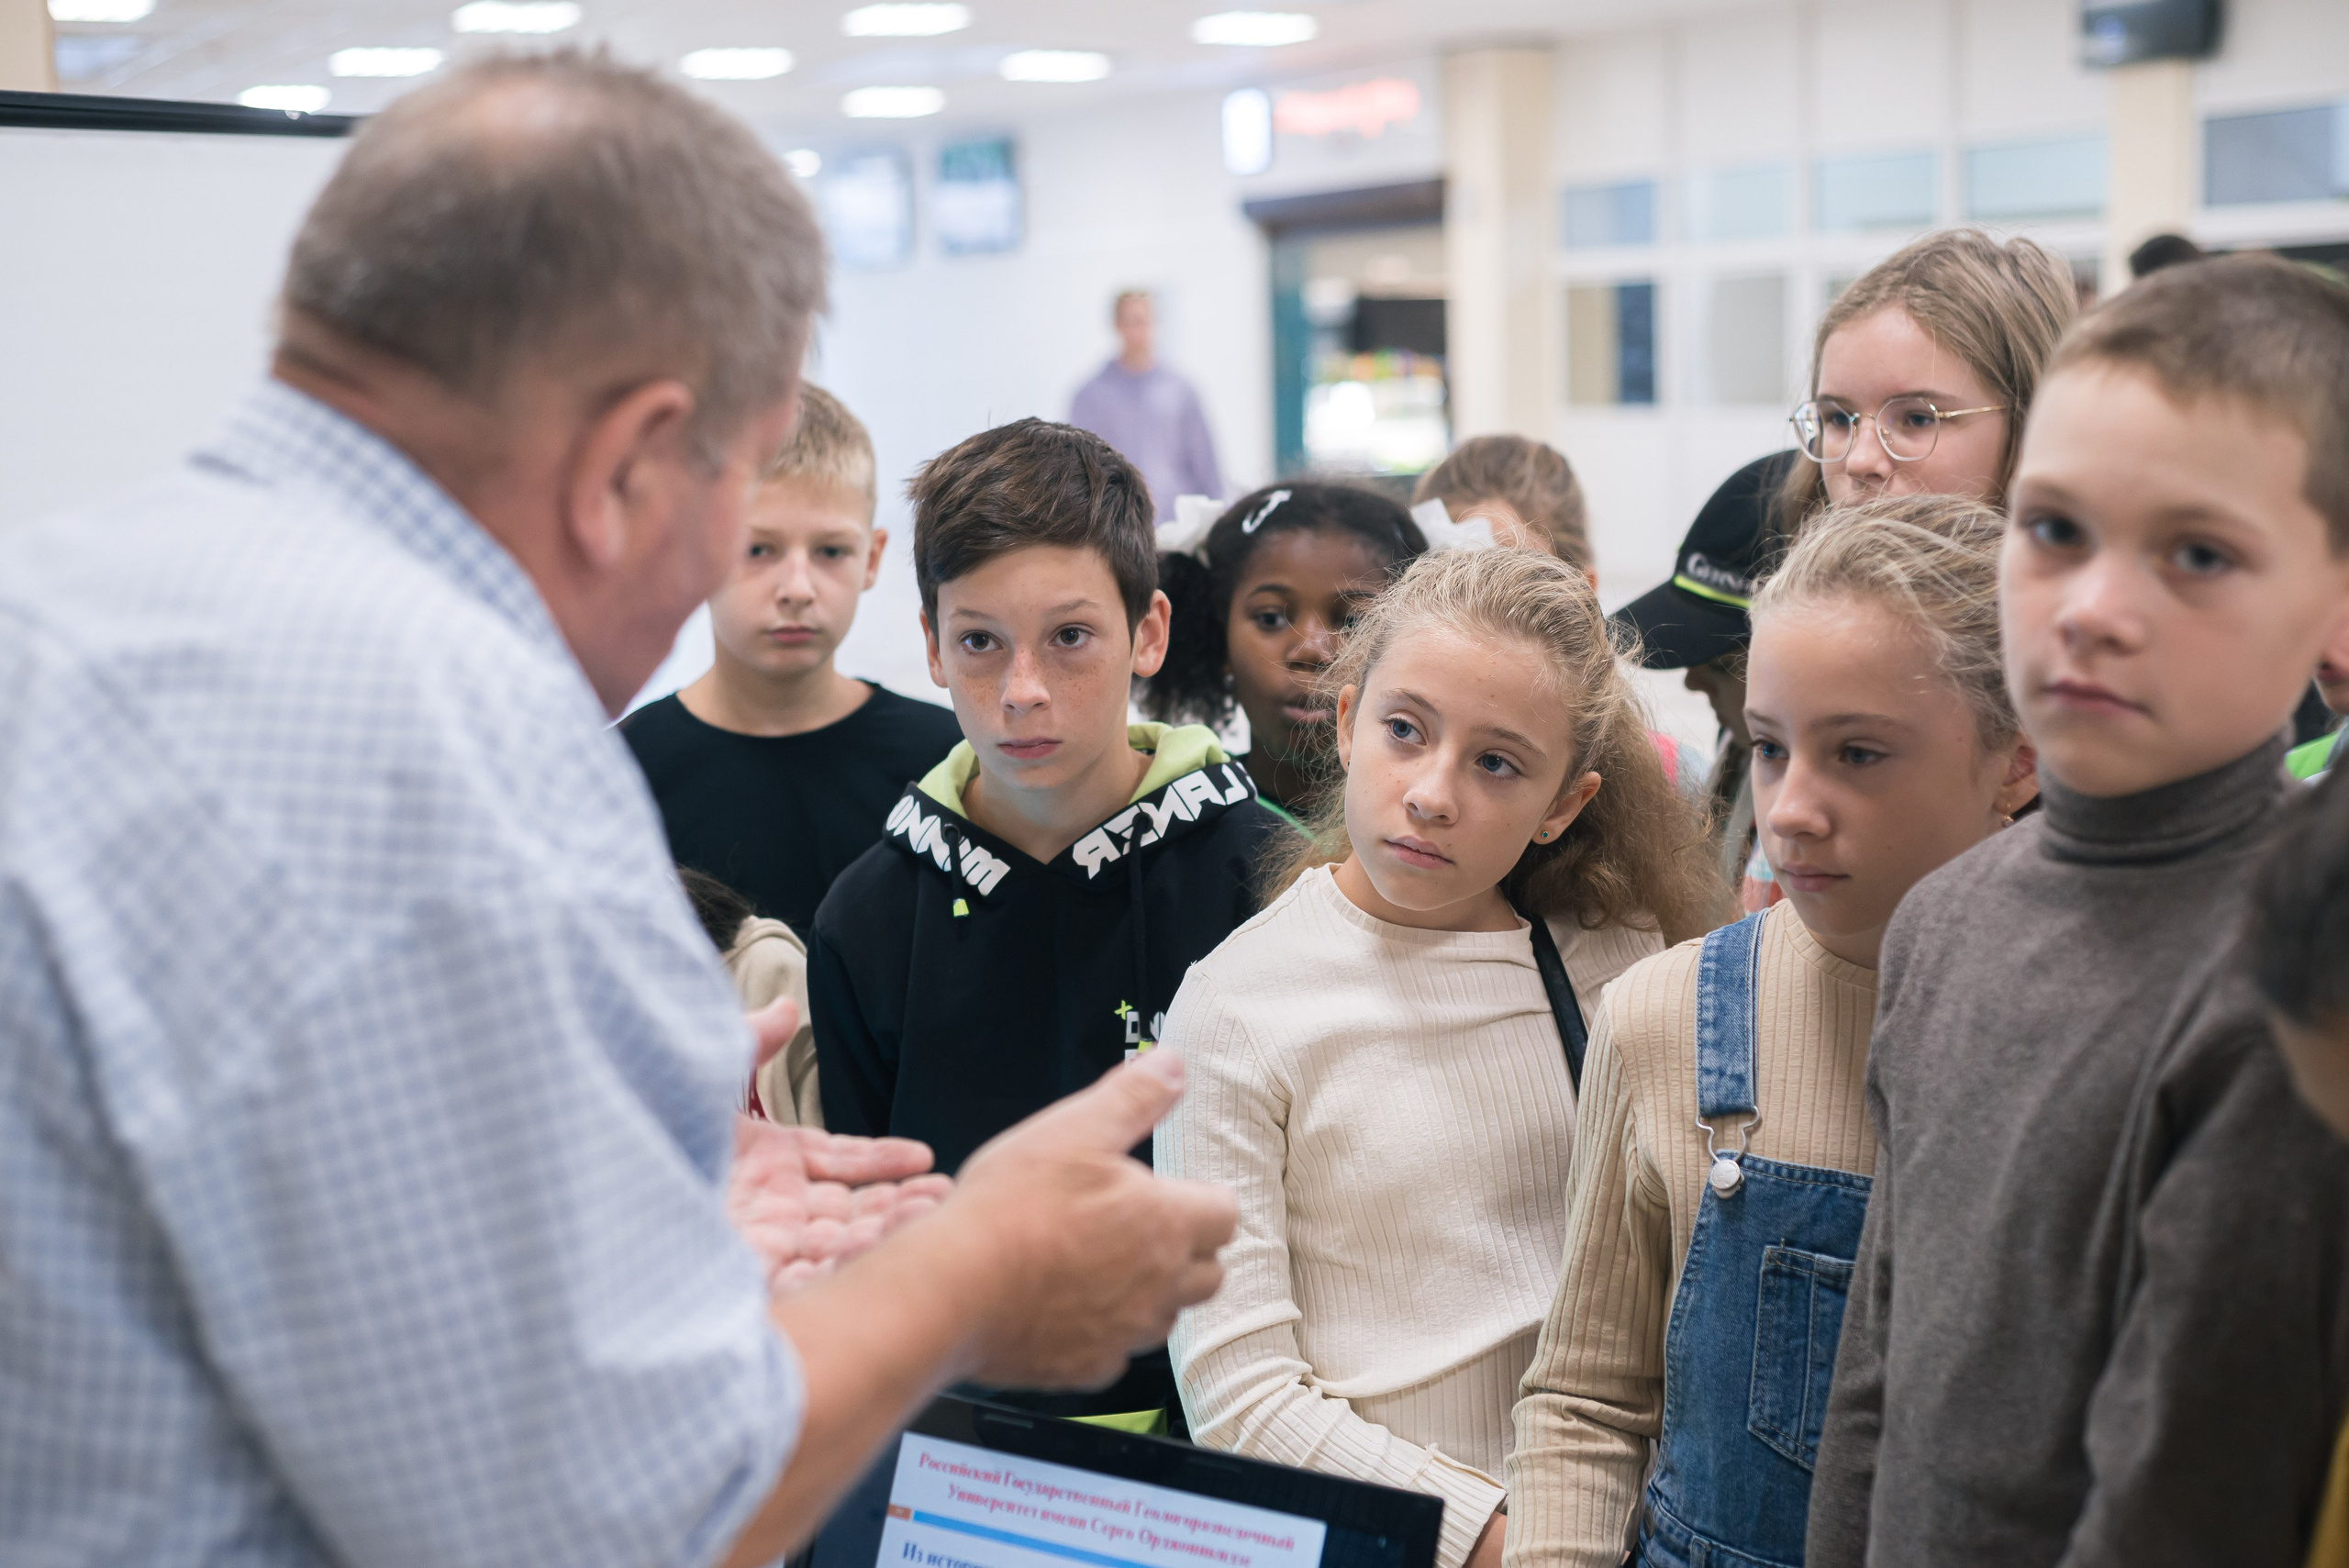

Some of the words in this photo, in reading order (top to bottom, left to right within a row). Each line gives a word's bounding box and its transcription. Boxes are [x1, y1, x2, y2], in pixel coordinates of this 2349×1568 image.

[919, 1452, 1002, 1485] Российский
[1004, 1473, 1130, 1513] Государственный
[903, 1542, 923, 1563] Из
[948, 1484, 1037, 1518] Университет
[1041, 1509, 1087, 1529] имени
[1090, 1518, 1134, 1541] Серго
[1138, 1528, 1251, 1566] Орджоникидзе
